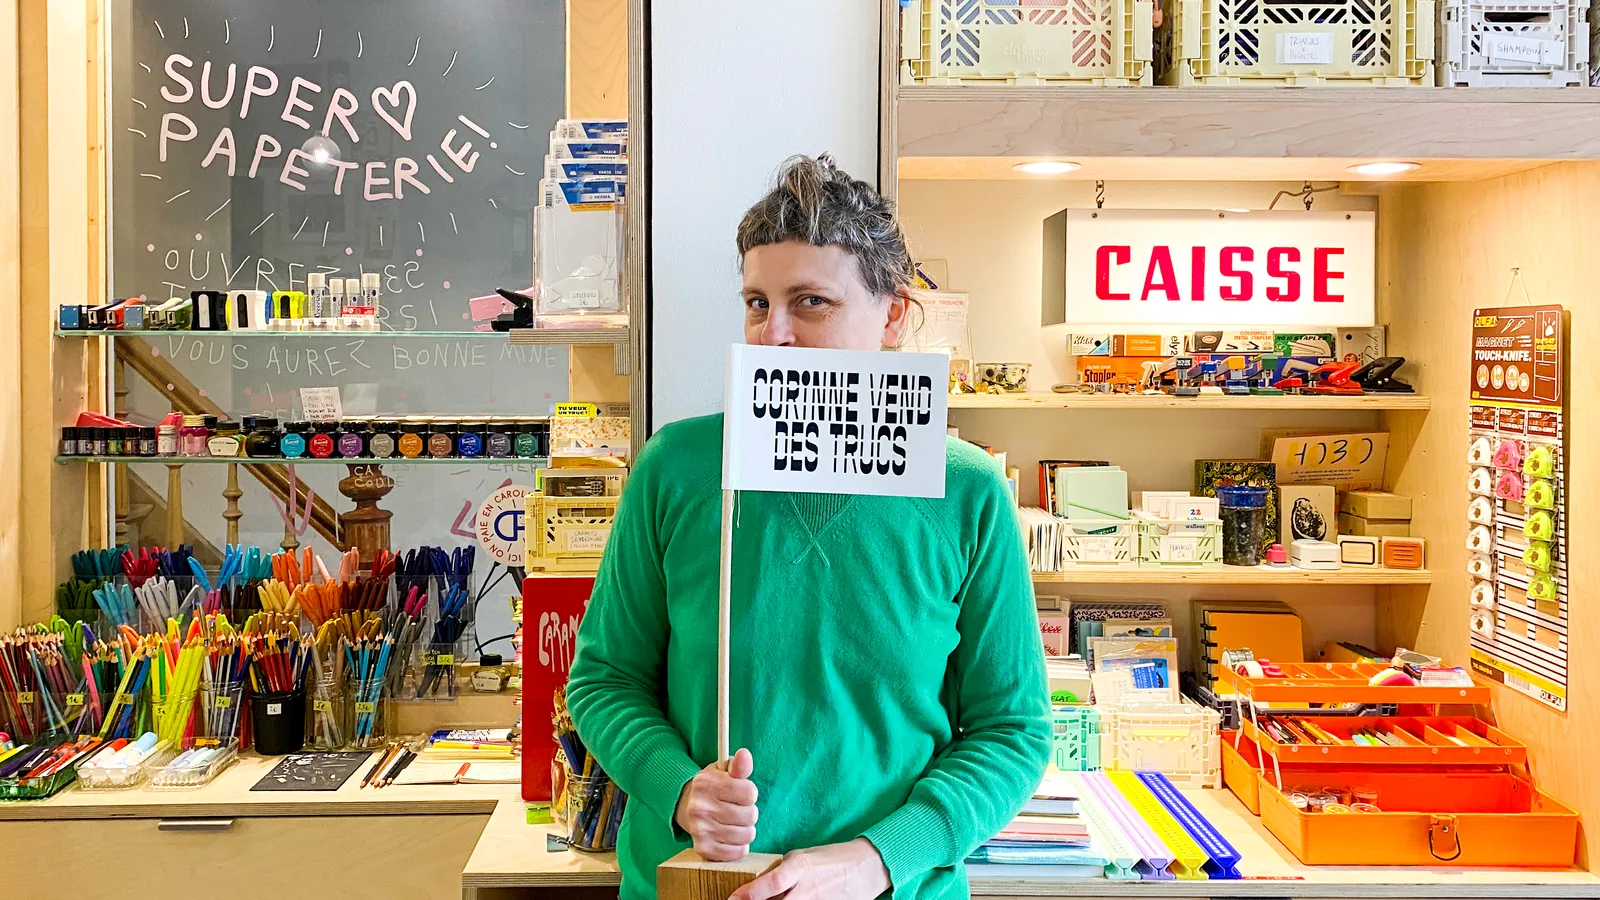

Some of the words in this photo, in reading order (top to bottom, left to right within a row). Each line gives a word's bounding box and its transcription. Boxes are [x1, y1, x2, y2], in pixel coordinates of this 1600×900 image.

[1497, 42, 1549, 56] SHAMPOIN
[160, 53, 359, 142] SUPER
[159, 113, 499, 200] PAPETERIE!
[1095, 244, 1345, 303] CAISSE
[1474, 316, 1497, 327] OLFA
[1475, 336, 1515, 348] MAGNET
[168, 336, 249, 369] VOUS
[266, 340, 371, 376] AUREZ
[393, 341, 487, 370] BONNE
[499, 343, 556, 368] MINE
[1084, 368, 1117, 384] Stapler
[753, 368, 860, 422] CORINNE
[870, 373, 932, 426] VEND
[774, 421, 820, 473] DES
[829, 422, 907, 477] TRUCS
[354, 465, 374, 480] ÇA
[482, 503, 494, 517] EN
[479, 521, 492, 543] PAIE
[488, 544, 504, 558] ON
[508, 553, 522, 562] ICI
[1540, 689, 1562, 706] OLFA
